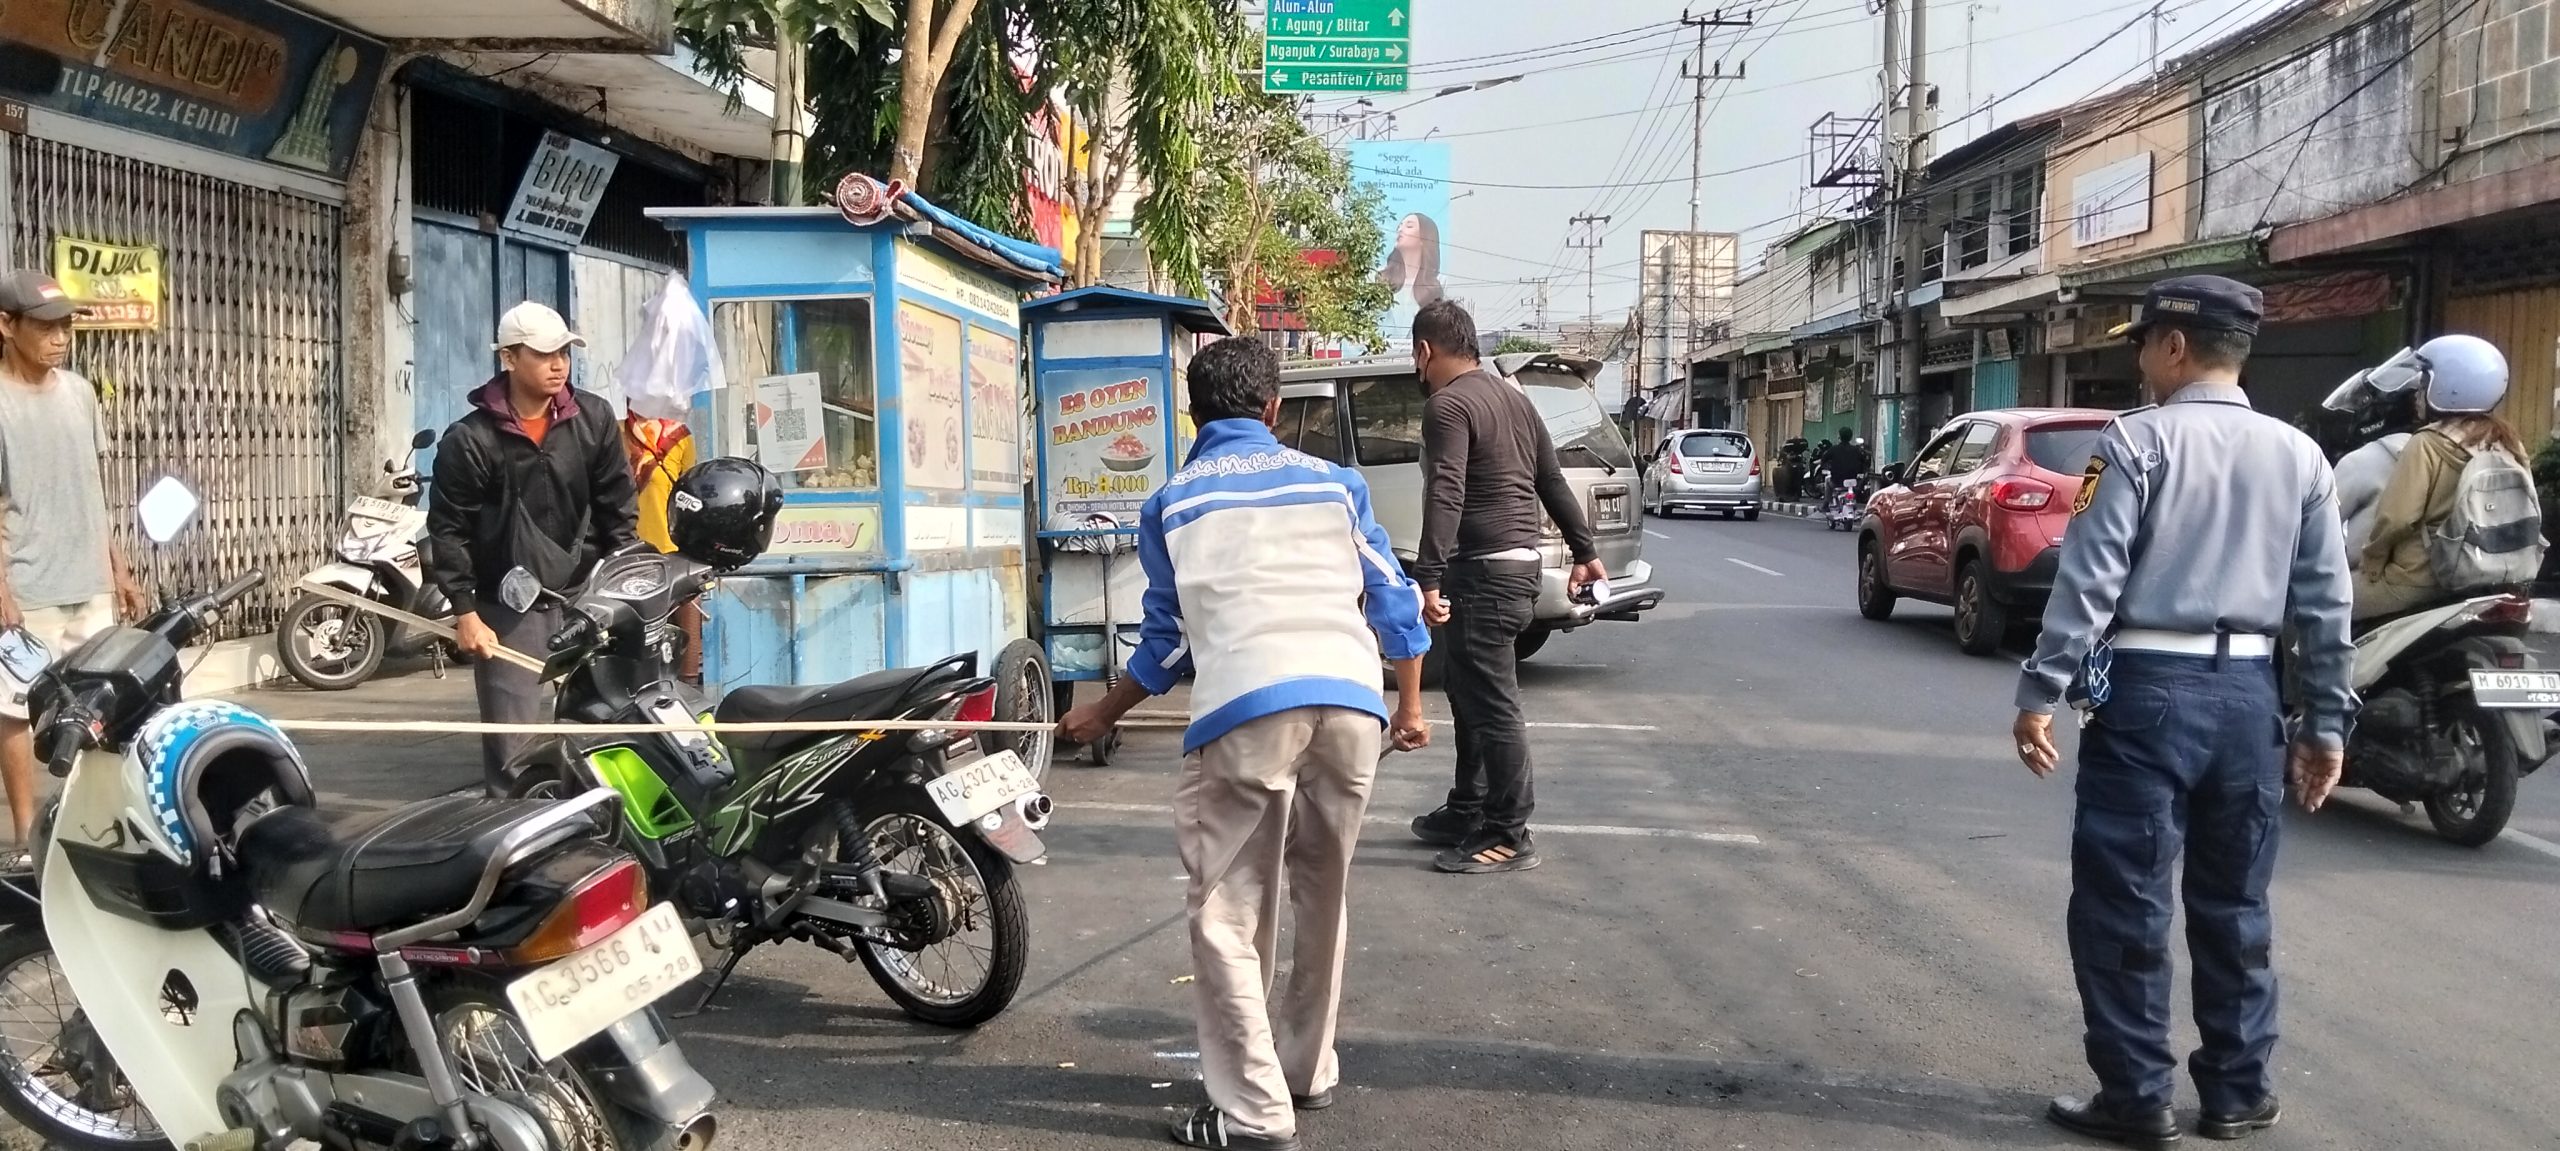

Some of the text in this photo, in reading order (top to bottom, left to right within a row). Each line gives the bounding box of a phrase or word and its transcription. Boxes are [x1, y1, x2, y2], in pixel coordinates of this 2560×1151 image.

[1273, 0, 1334, 13] Alun-Alun
[1272, 18, 1369, 34] T. Agung / Blitar
[1270, 44, 1380, 60] Nganjuk / Surabaya
[1302, 72, 1403, 87] Pesantren / Pare
[5, 104, 24, 119] 157
[168, 100, 241, 138] KEDIRI
[1375, 166, 1422, 179] kayak ada
[69, 245, 152, 276] DIJUAL
[1060, 377, 1149, 415] ES OYEN
[1053, 406, 1158, 445] BANDUNG
[1065, 476, 1094, 498] Rp.
[936, 781, 959, 804] AG
[520, 980, 558, 1018] AG
[560, 940, 631, 994] 3566
[624, 956, 690, 1001] 05-28
